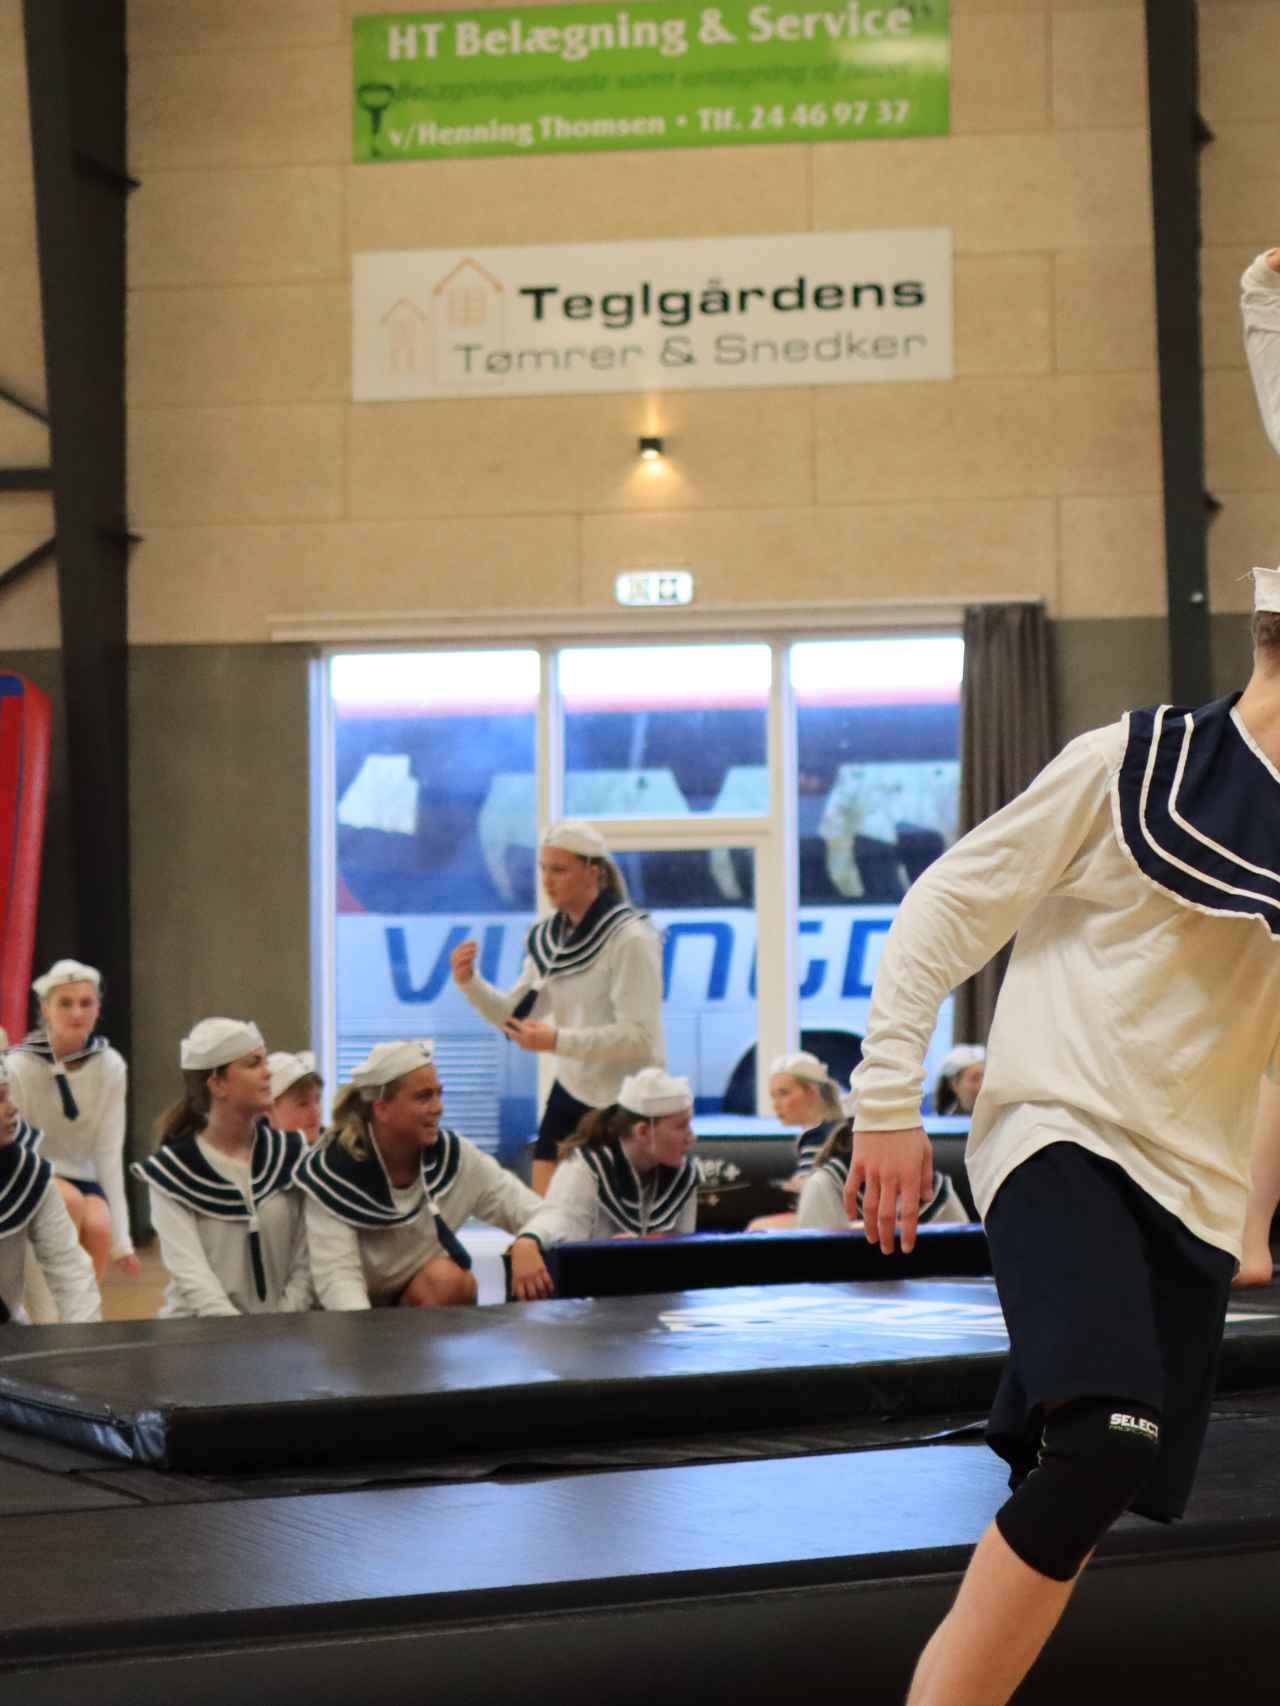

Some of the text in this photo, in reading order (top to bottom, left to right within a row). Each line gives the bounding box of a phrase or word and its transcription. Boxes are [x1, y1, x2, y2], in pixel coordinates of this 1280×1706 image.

[388, 2, 912, 61] HT Belægning & Service
[539, 114, 666, 140] Thomsen
[790, 102, 828, 128] 46
[519, 275, 926, 329] Teglgårdens
[453, 329, 929, 376] Tømrer & Snedker
